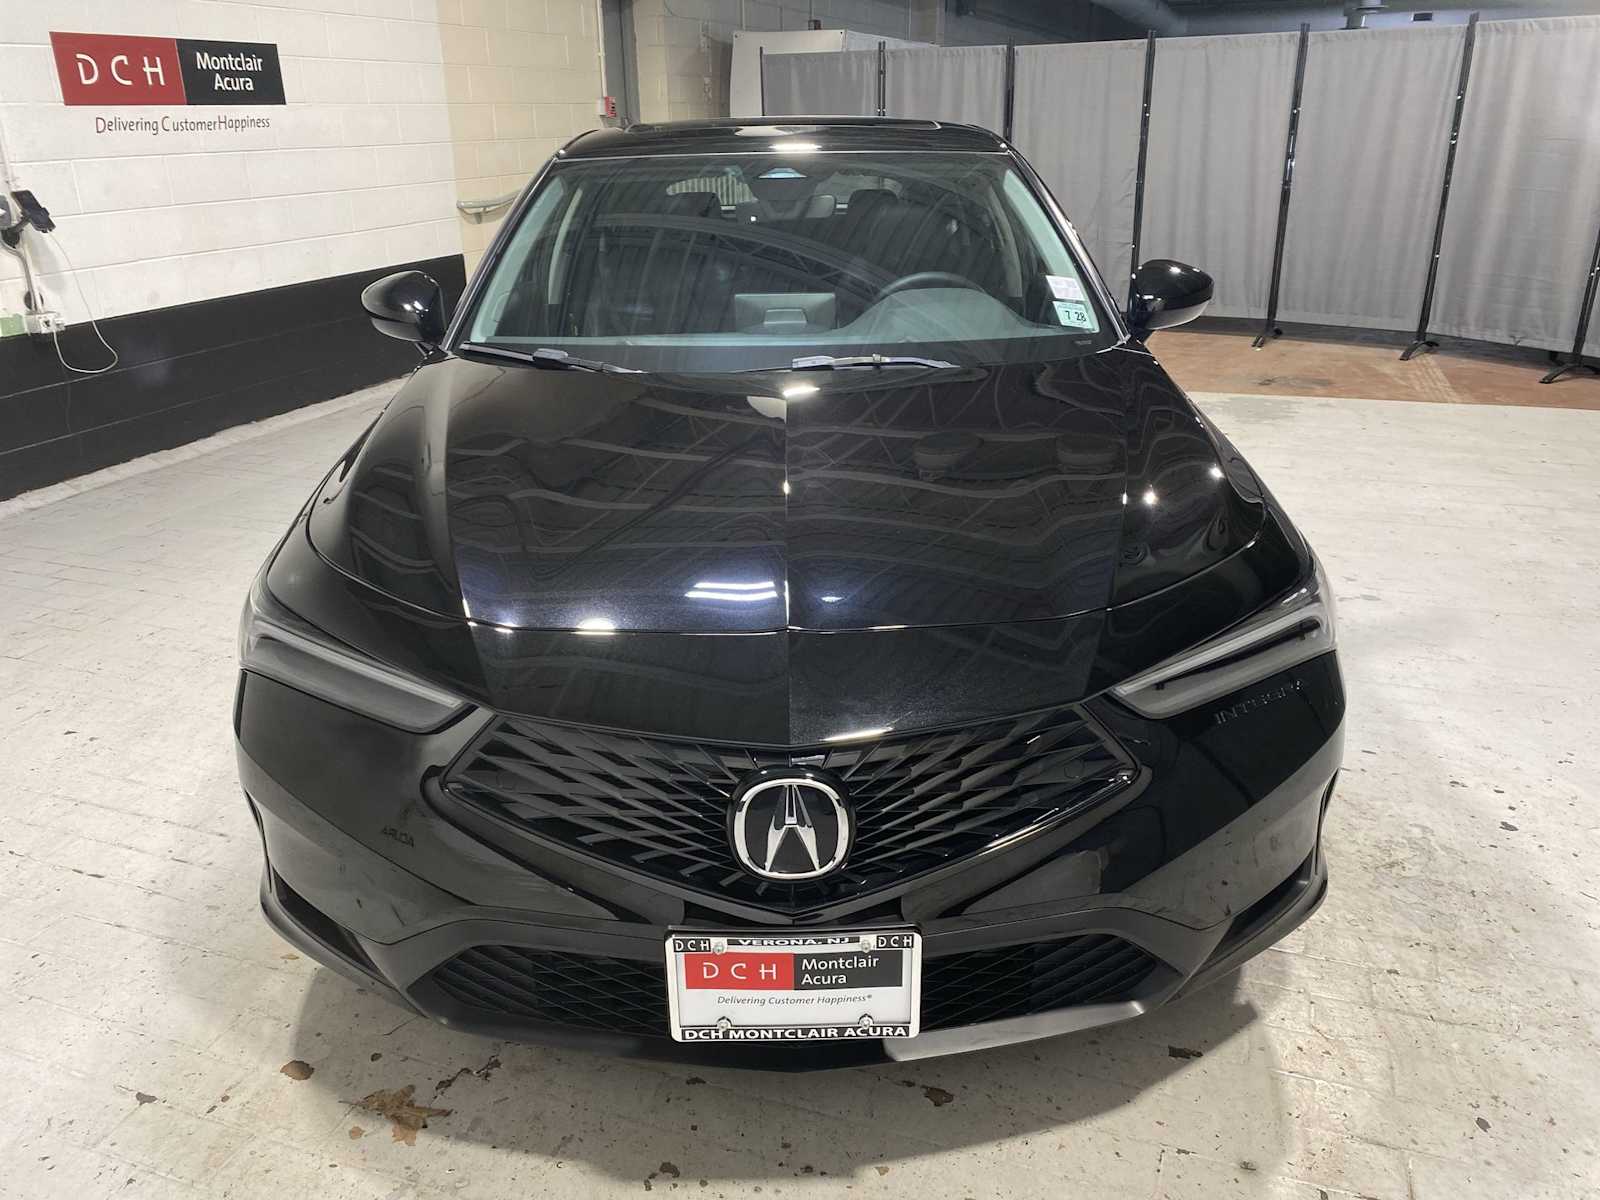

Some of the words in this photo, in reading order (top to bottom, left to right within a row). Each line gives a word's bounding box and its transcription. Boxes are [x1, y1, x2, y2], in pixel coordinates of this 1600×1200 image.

[196, 51, 263, 72] Montclair
[76, 53, 166, 86] DCH
[213, 73, 255, 91] Acura
[95, 116, 159, 135] Delivering
[1065, 310, 1071, 320] 7
[1074, 311, 1087, 322] 28
[674, 940, 710, 951] DCH
[827, 937, 849, 945] NJ
[878, 936, 912, 948] DCH
[801, 955, 880, 971] Montclair
[702, 962, 777, 980] DCH
[801, 973, 848, 985] Acura
[717, 996, 766, 1006] Delivering
[768, 996, 814, 1005] Customer
[684, 1030, 724, 1040] DCH
[729, 1028, 839, 1040] MONTCLAIR
[843, 1026, 907, 1037] ACURA
